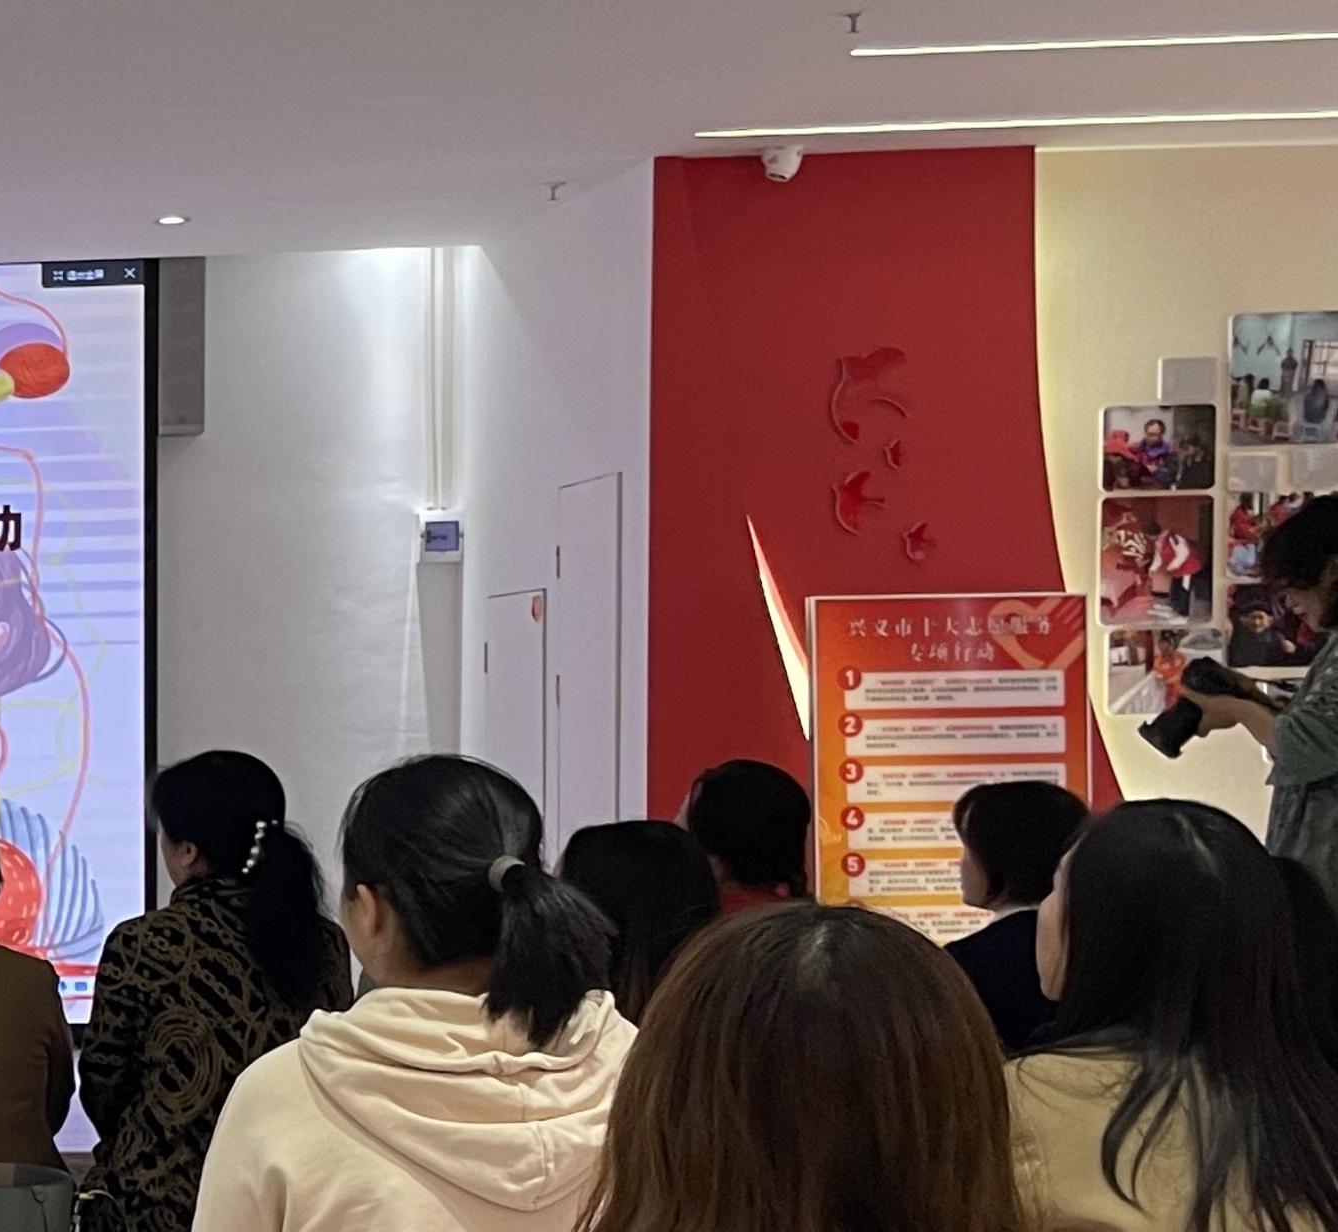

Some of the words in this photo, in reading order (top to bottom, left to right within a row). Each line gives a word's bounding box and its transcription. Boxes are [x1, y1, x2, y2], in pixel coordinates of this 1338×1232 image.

[844, 670, 854, 686] 1
[844, 716, 857, 733] 2
[845, 763, 857, 780] 3
[846, 809, 859, 826] 4
[846, 856, 859, 873] 5
